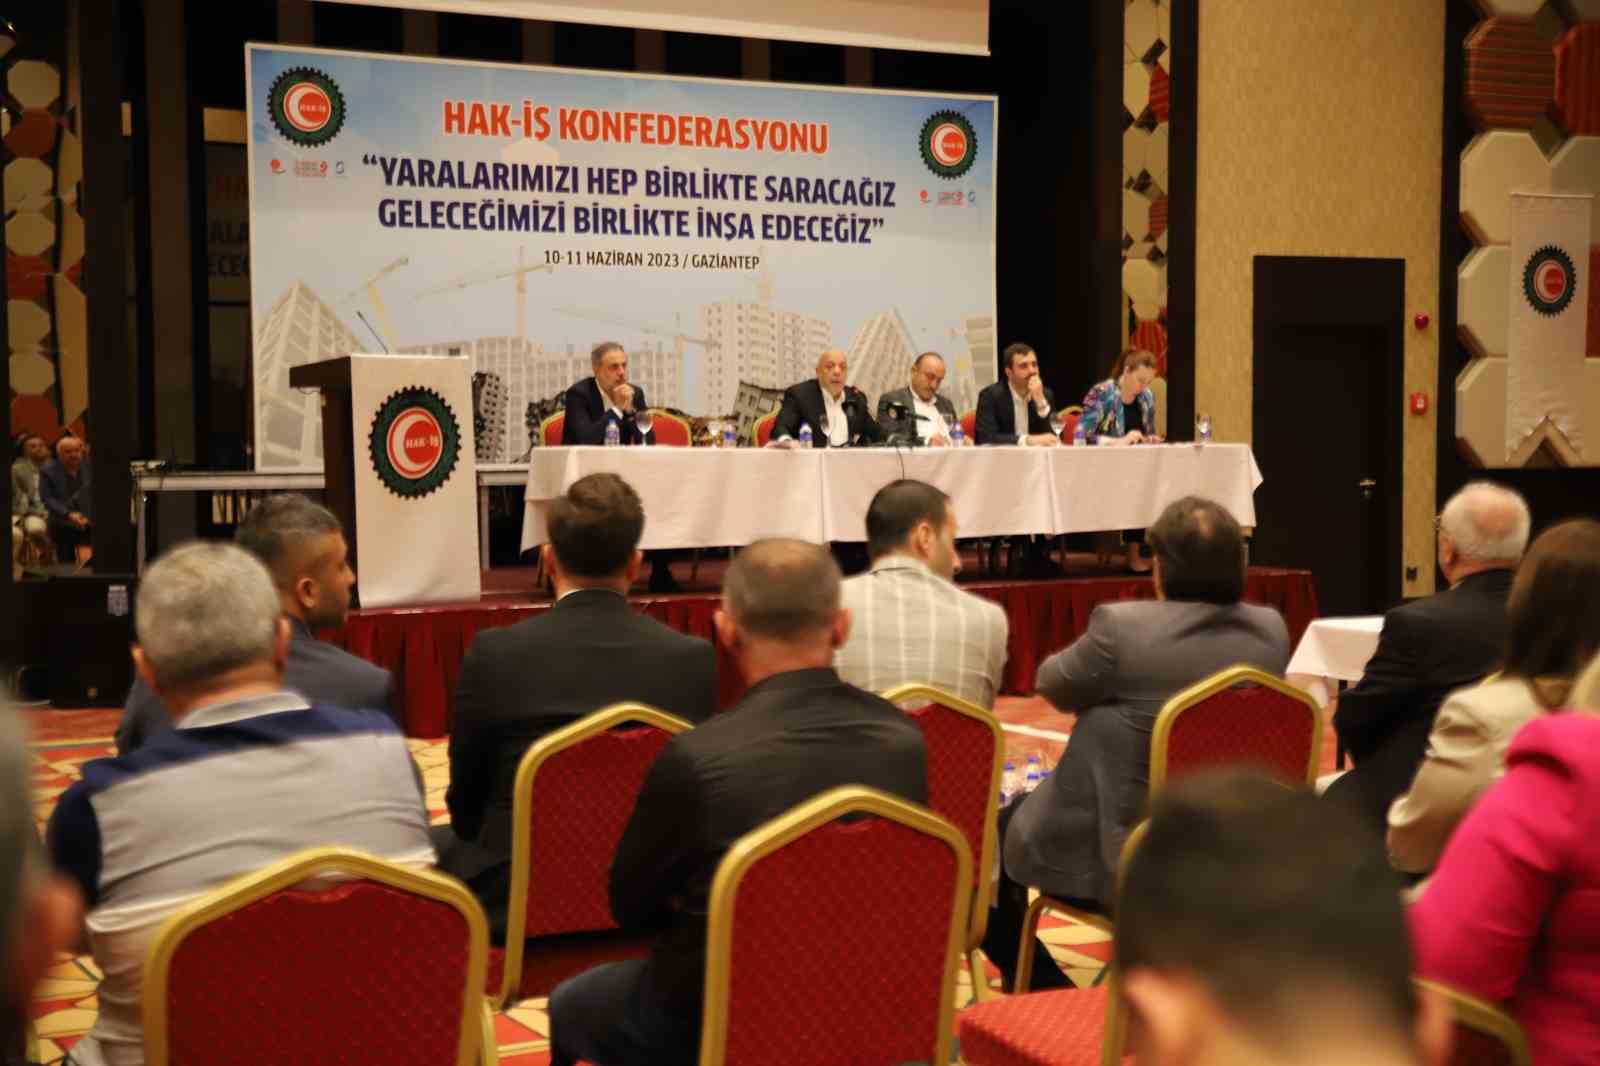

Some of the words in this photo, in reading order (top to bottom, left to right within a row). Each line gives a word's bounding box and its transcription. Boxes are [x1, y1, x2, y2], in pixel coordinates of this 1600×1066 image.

[444, 100, 550, 142] HAK-İŞ
[559, 108, 829, 154] KONFEDERASYONU
[587, 167, 638, 196] HEP
[645, 166, 758, 202] BİRLİKTE
[764, 174, 896, 208] SARACAĞIZ
[378, 197, 565, 233] GELECEĞİMİZİ
[574, 202, 690, 237] BİRLİKTE
[697, 206, 755, 242] İNŞA
[544, 250, 582, 265] 10-11
[586, 249, 643, 267] HAZİRAN
[647, 252, 679, 268] 2023
[691, 252, 760, 270] GAZİANTEP
